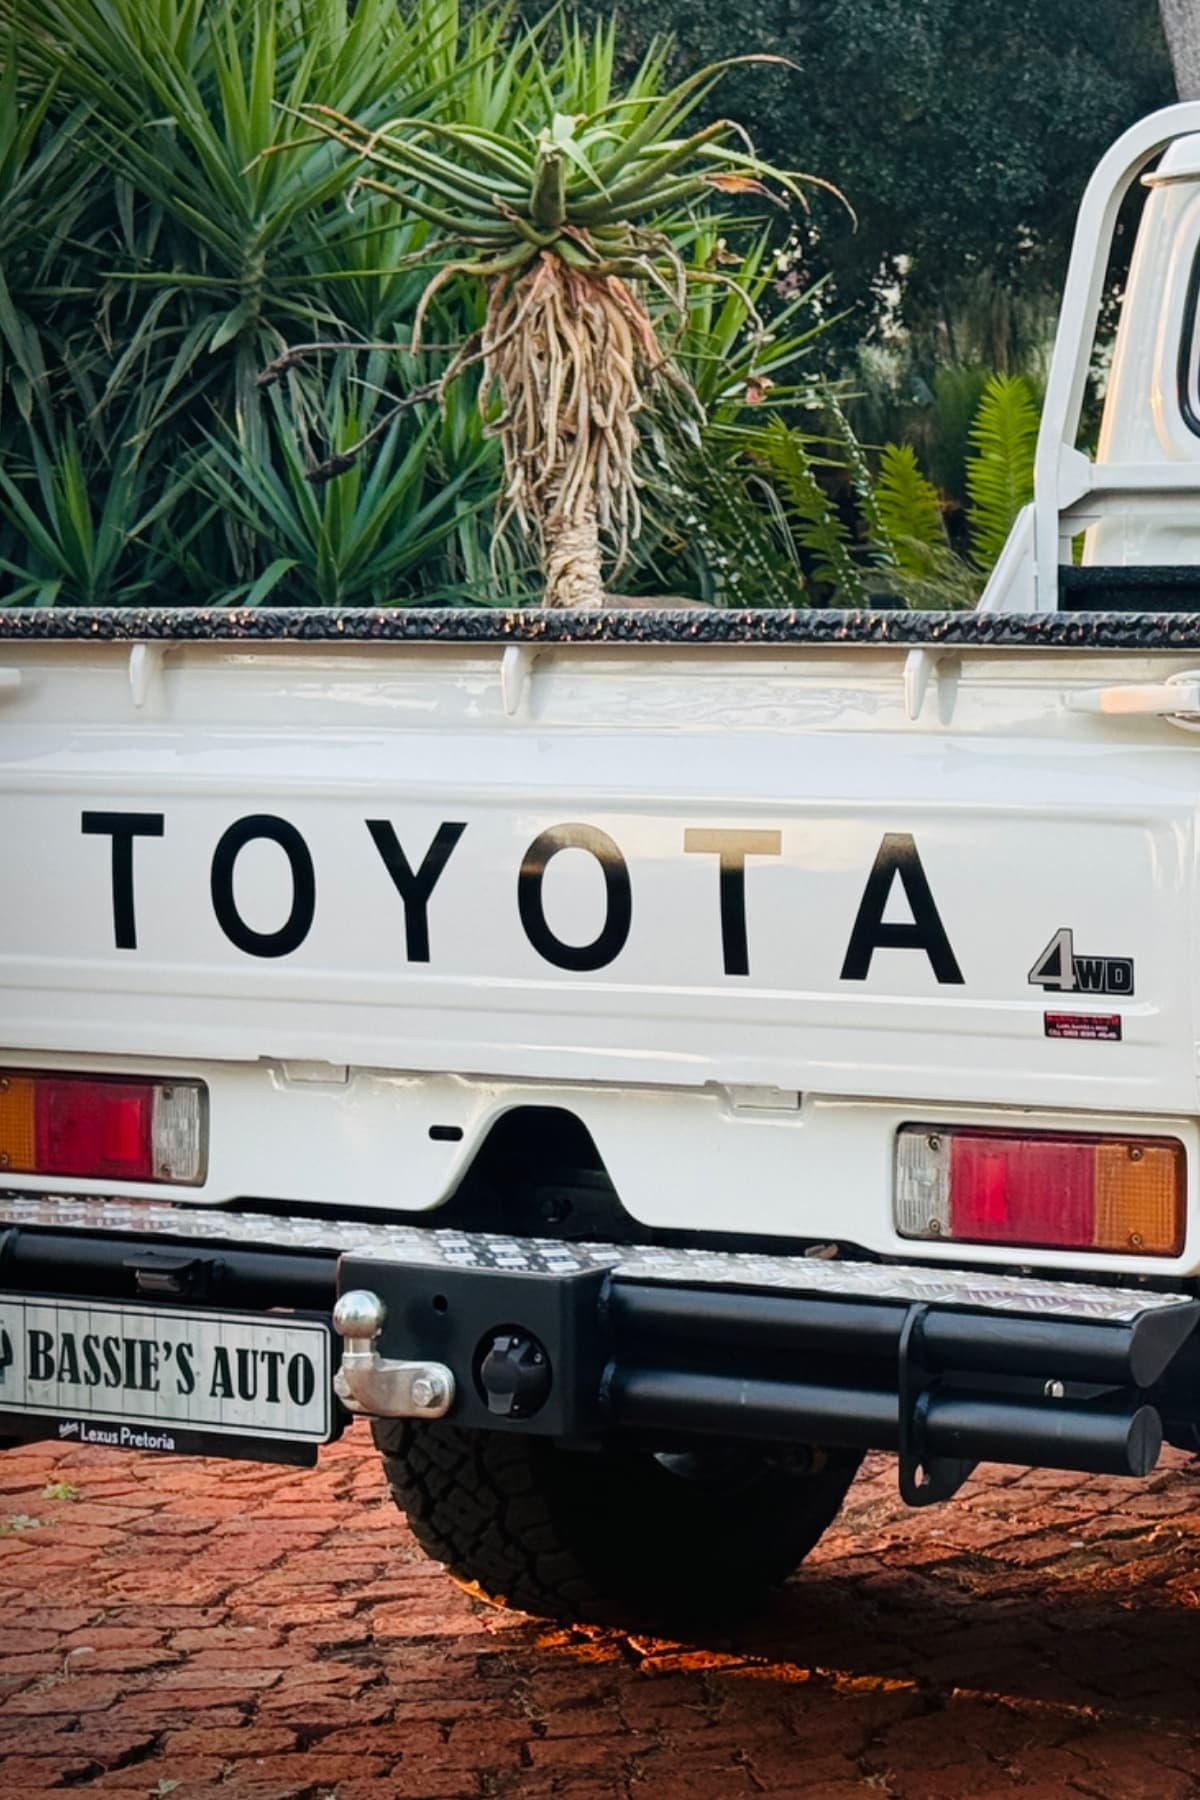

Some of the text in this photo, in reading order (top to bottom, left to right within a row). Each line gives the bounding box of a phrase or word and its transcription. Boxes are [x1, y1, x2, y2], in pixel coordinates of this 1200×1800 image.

[81, 811, 965, 984] TOYOTA
[1028, 928, 1134, 995] 4WD
[28, 1330, 315, 1406] BASSIE'S AUTO
[81, 1421, 118, 1444] Lexus
[120, 1426, 175, 1450] Pretoria
